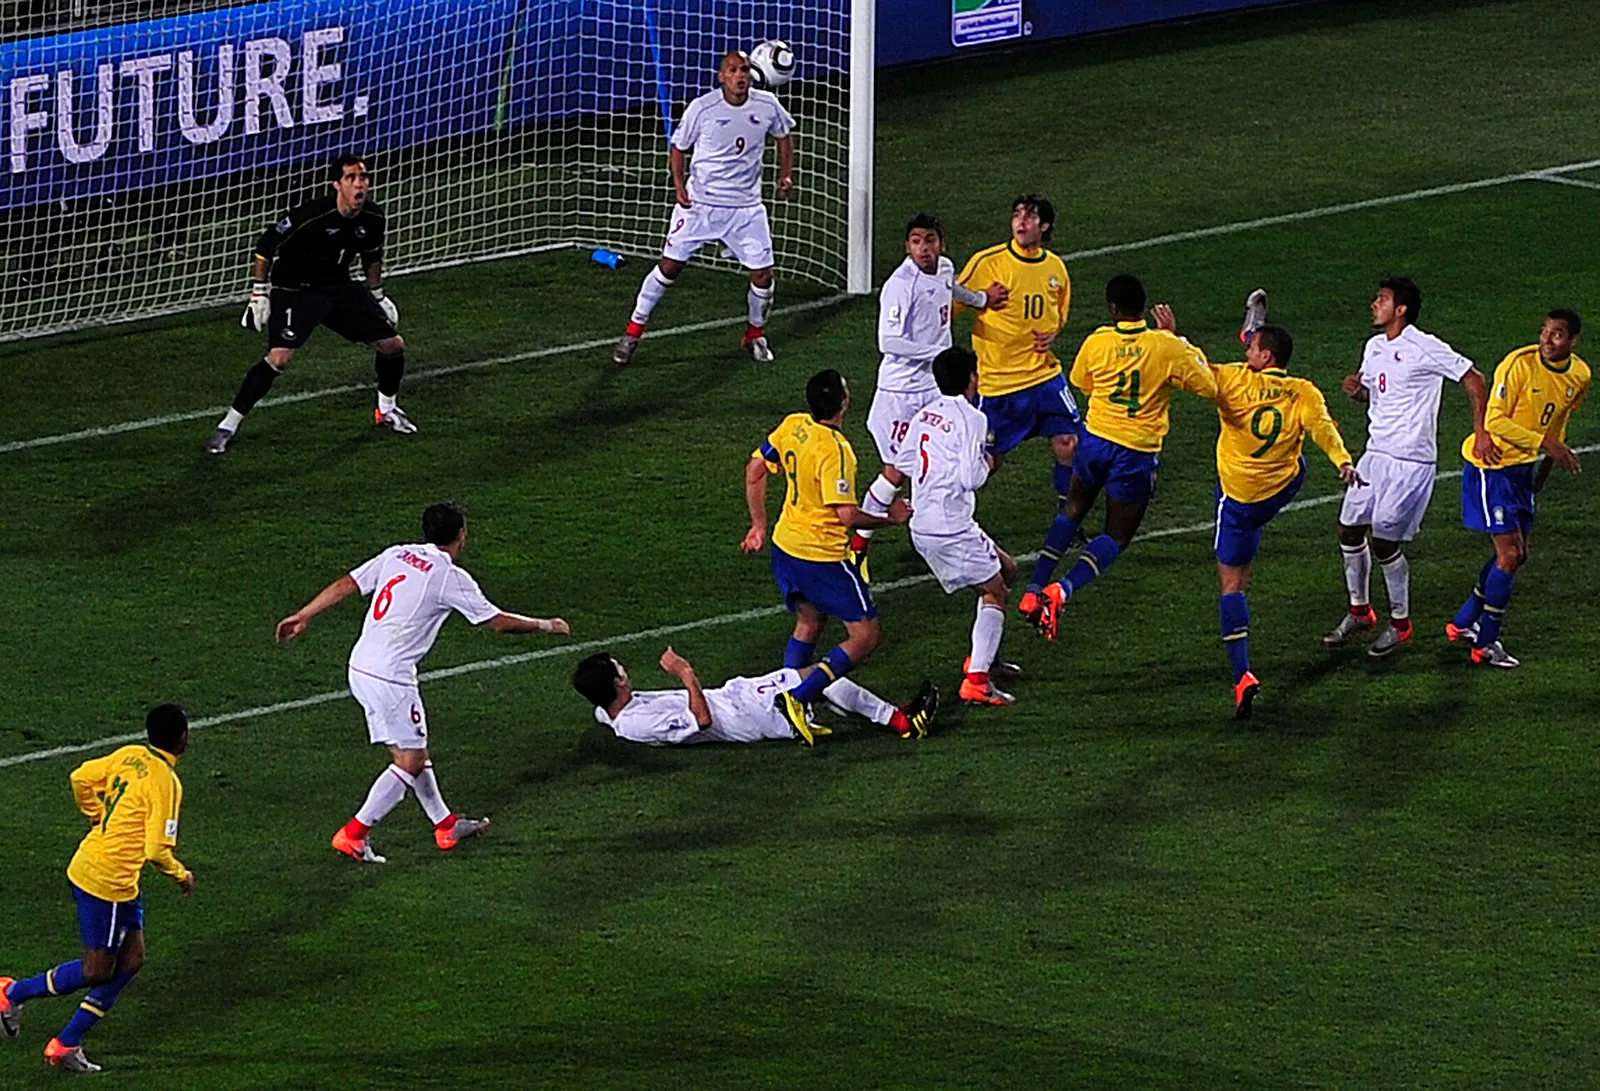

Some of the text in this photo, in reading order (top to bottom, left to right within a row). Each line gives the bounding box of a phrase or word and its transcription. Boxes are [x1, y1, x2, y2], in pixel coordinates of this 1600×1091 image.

[10, 26, 369, 173] FUTURE.
[735, 137, 745, 155] 9
[285, 308, 292, 326] 1
[1024, 294, 1044, 320] 10
[1379, 373, 1386, 393] 8
[1541, 402, 1555, 426] 8
[890, 420, 909, 443] 18
[1250, 406, 1283, 458] 9
[373, 574, 407, 621] 6
[410, 703, 421, 724] 6
